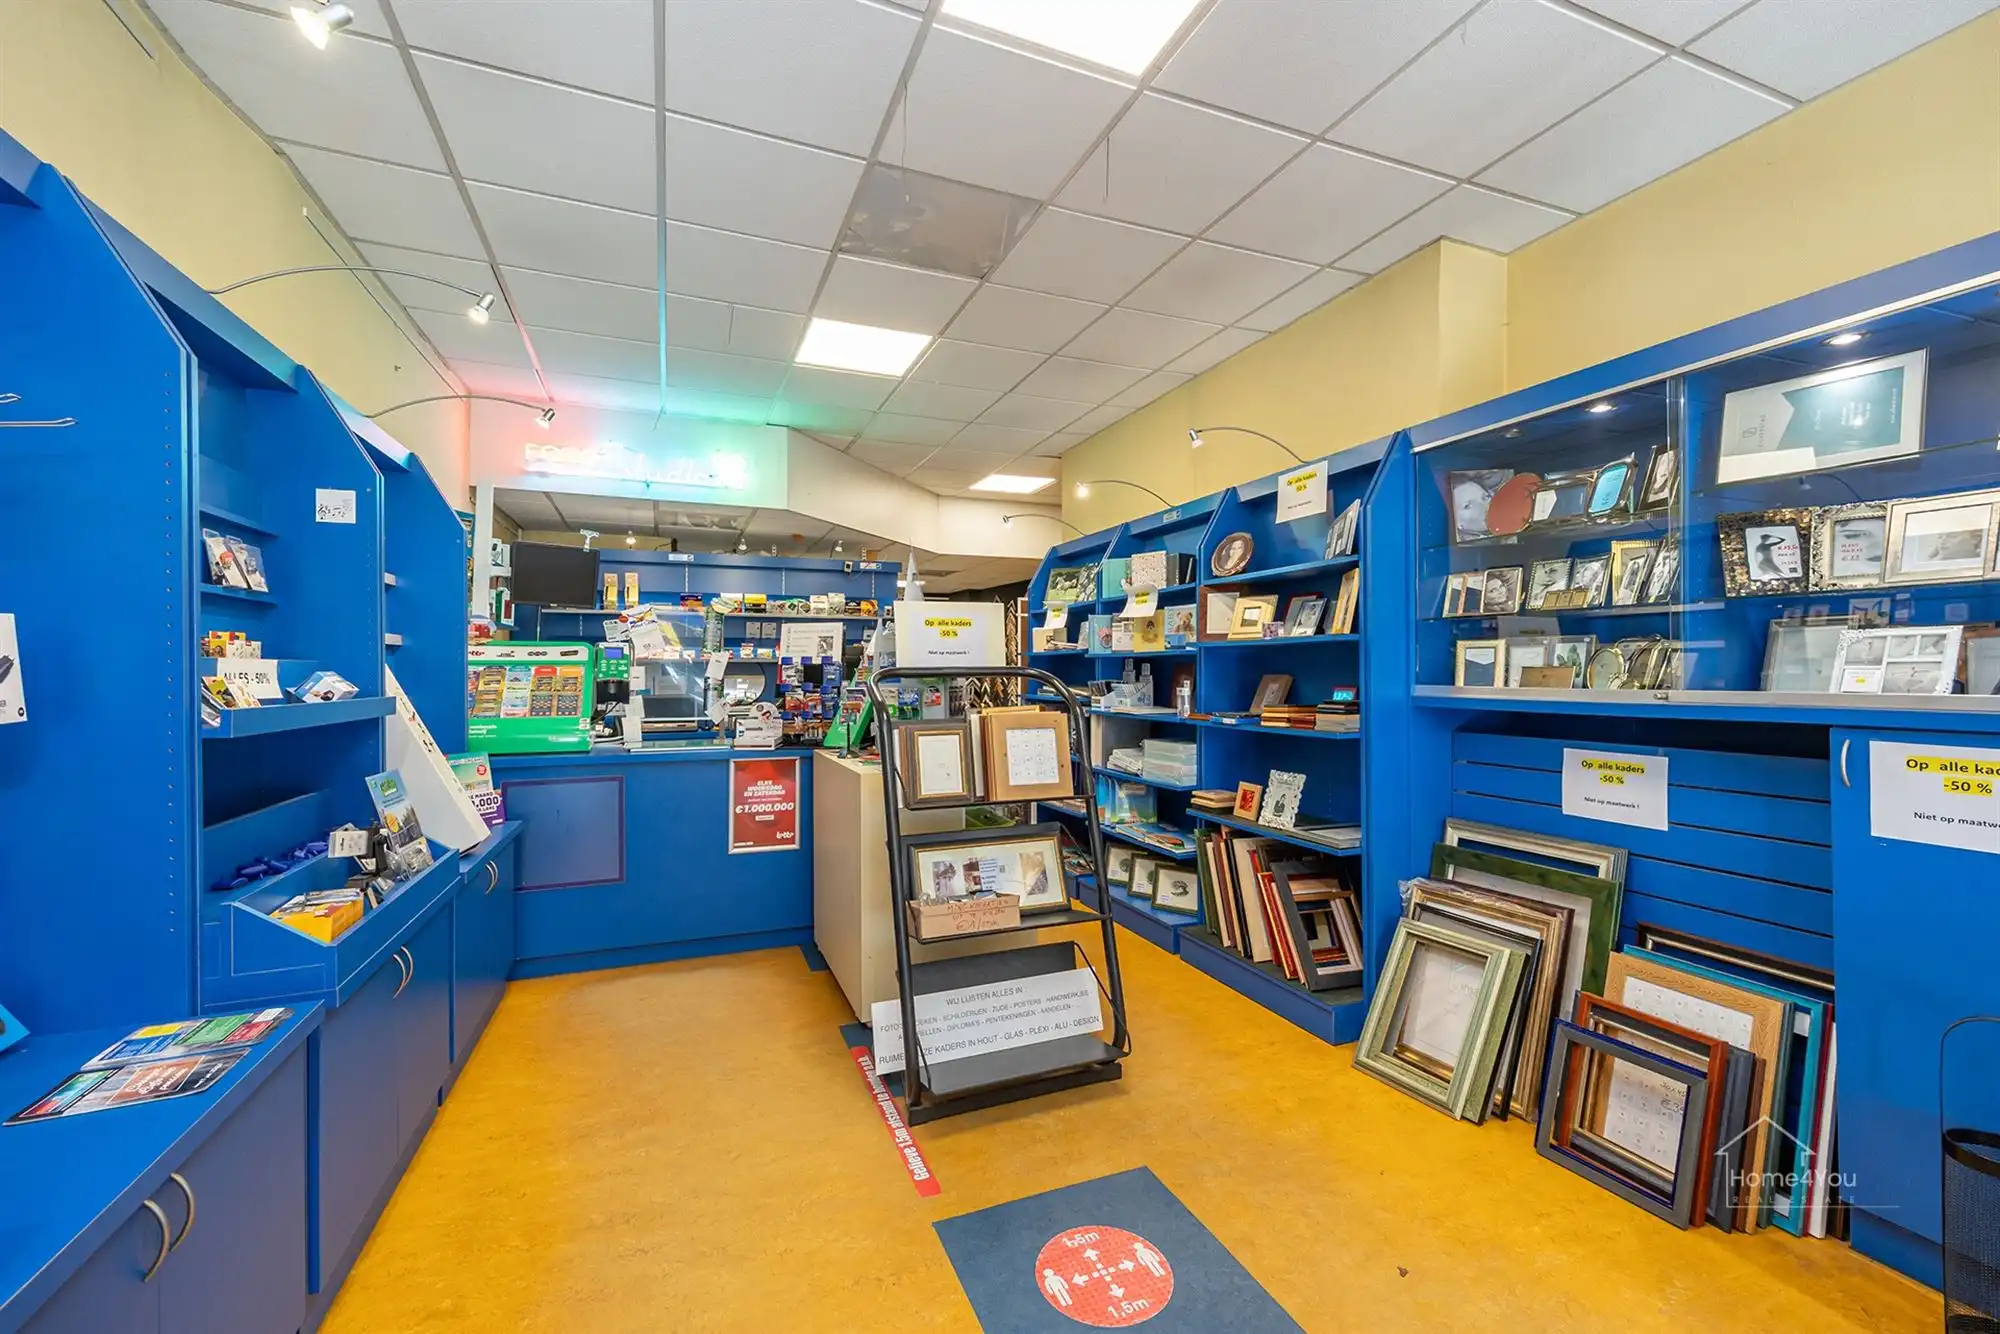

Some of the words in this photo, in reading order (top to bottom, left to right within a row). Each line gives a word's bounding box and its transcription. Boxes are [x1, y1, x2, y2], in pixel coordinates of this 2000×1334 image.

[925, 619, 935, 627] Op
[950, 619, 972, 627] kaders
[255, 672, 271, 685] 50%
[1581, 760, 1594, 769] Op
[1598, 762, 1613, 770] alle
[1615, 763, 1645, 774] kaders
[1906, 758, 1929, 772] Op
[1939, 761, 1969, 773] alle
[1599, 774, 1614, 783] -50
[1615, 776, 1625, 785] %
[1943, 780, 1971, 792] -50
[1976, 782, 1993, 794] %
[1606, 800, 1636, 809] maatwerk
[1913, 812, 1937, 821] Niet
[1940, 815, 1955, 825] op
[991, 987, 1014, 999] ALLES
[1015, 986, 1023, 994] IN
[1013, 998, 1042, 1009] POSTERS
[934, 1040, 967, 1054] KADERS
[968, 1039, 976, 1047] IN
[977, 1034, 998, 1045] HOUT
[1004, 1029, 1024, 1041] GLAS
[1029, 1024, 1050, 1036] PLEXI
[1054, 1021, 1068, 1031] ALU
[1073, 1015, 1100, 1027] DESIGN
[903, 1146, 930, 1181] Gelieve
[1107, 1298, 1150, 1319] 1,5m
